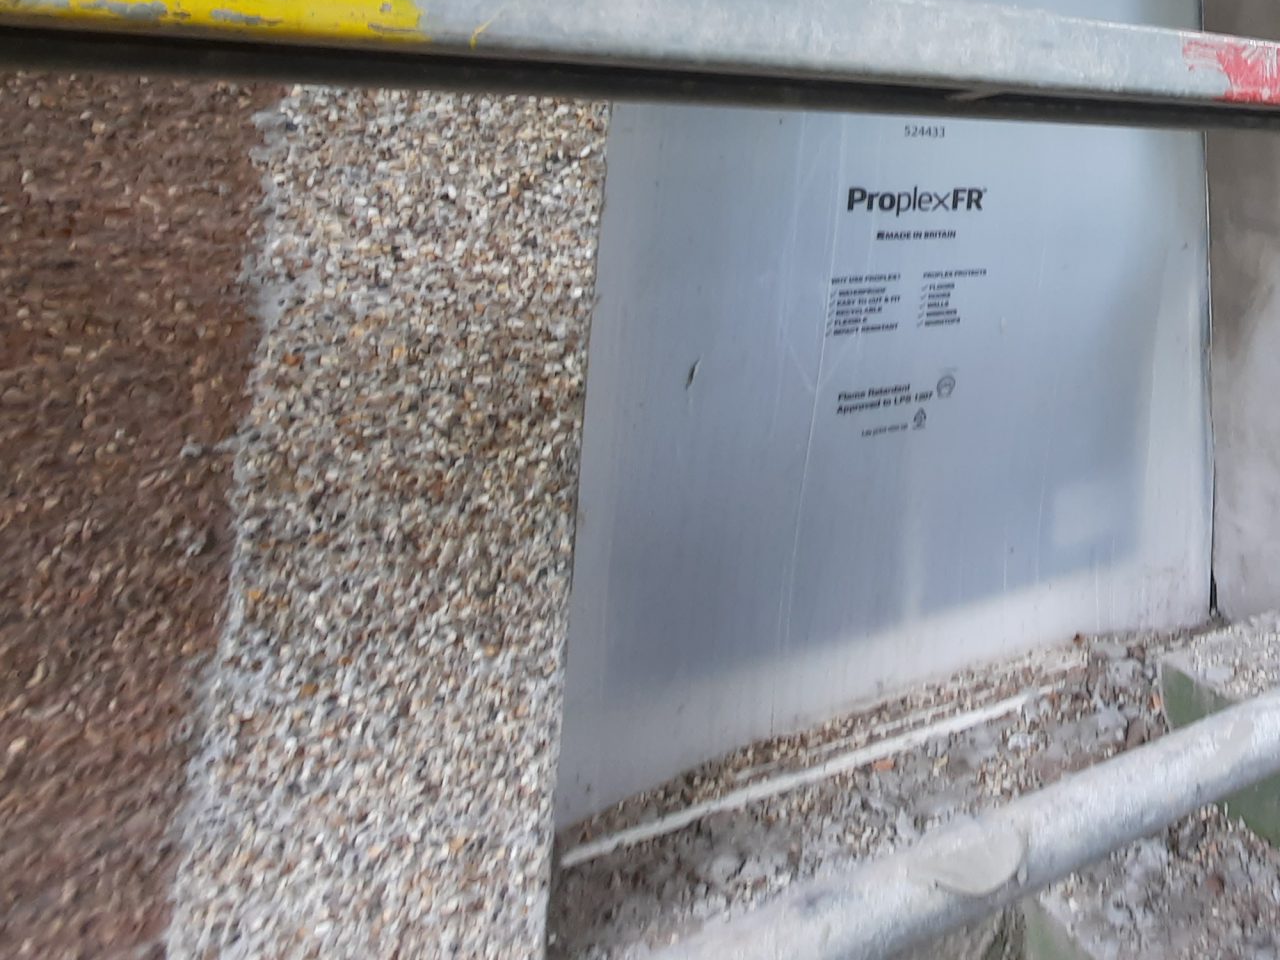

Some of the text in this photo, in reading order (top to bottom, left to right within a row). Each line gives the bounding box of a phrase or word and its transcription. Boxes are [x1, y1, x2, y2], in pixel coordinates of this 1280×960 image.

[904, 125, 945, 138] 524433
[885, 230, 956, 240] MADE IN BRITAIN
[837, 383, 910, 402] Flame Retardant
[836, 399, 881, 415] Approved
